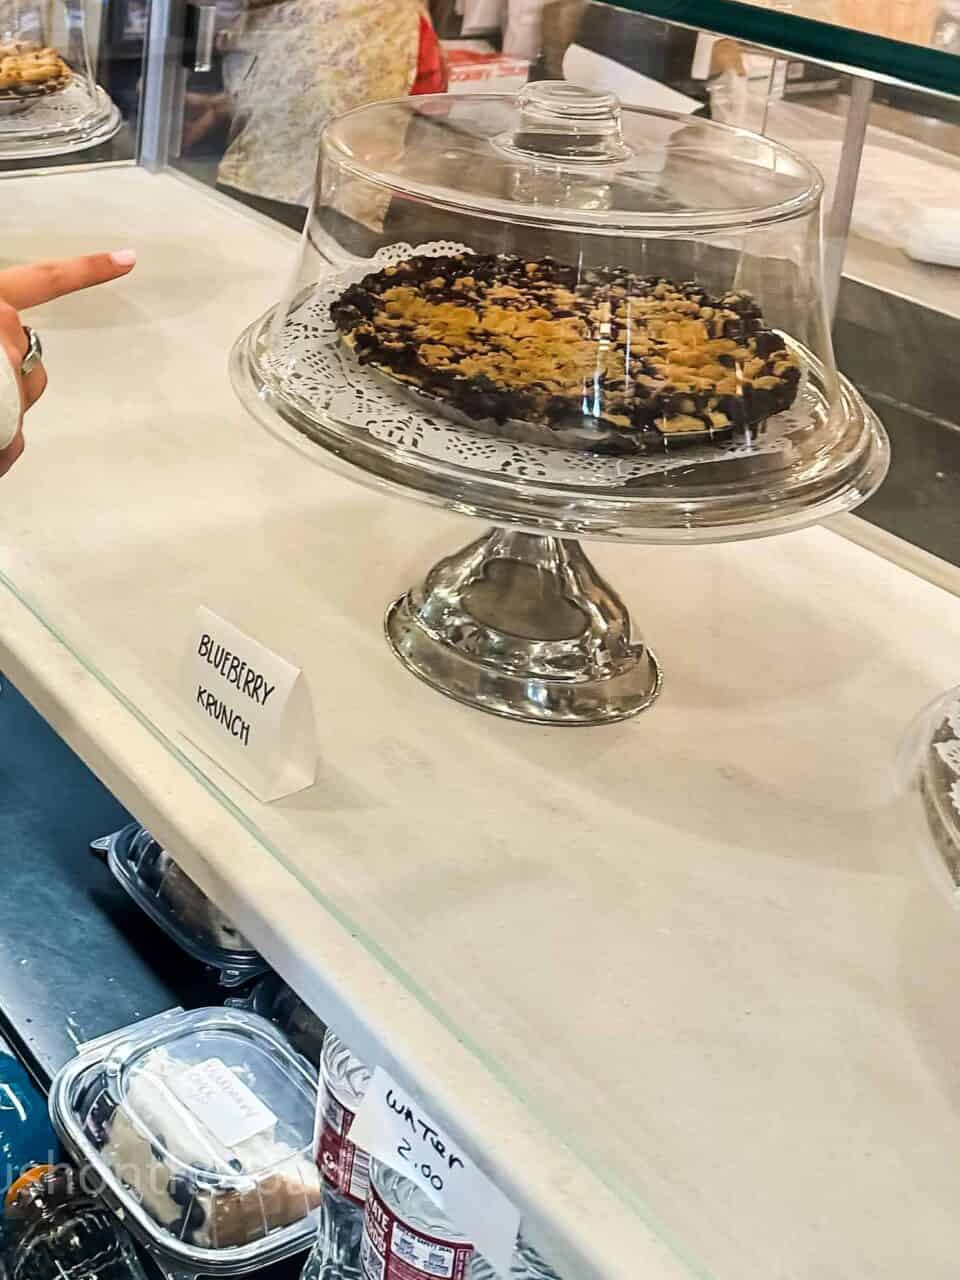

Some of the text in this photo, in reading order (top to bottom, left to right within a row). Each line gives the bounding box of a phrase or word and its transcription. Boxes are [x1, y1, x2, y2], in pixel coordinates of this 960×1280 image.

[197, 633, 276, 706] BLUEBERRY
[196, 684, 251, 747] KRUNCH
[396, 1136, 444, 1191] 2.00
